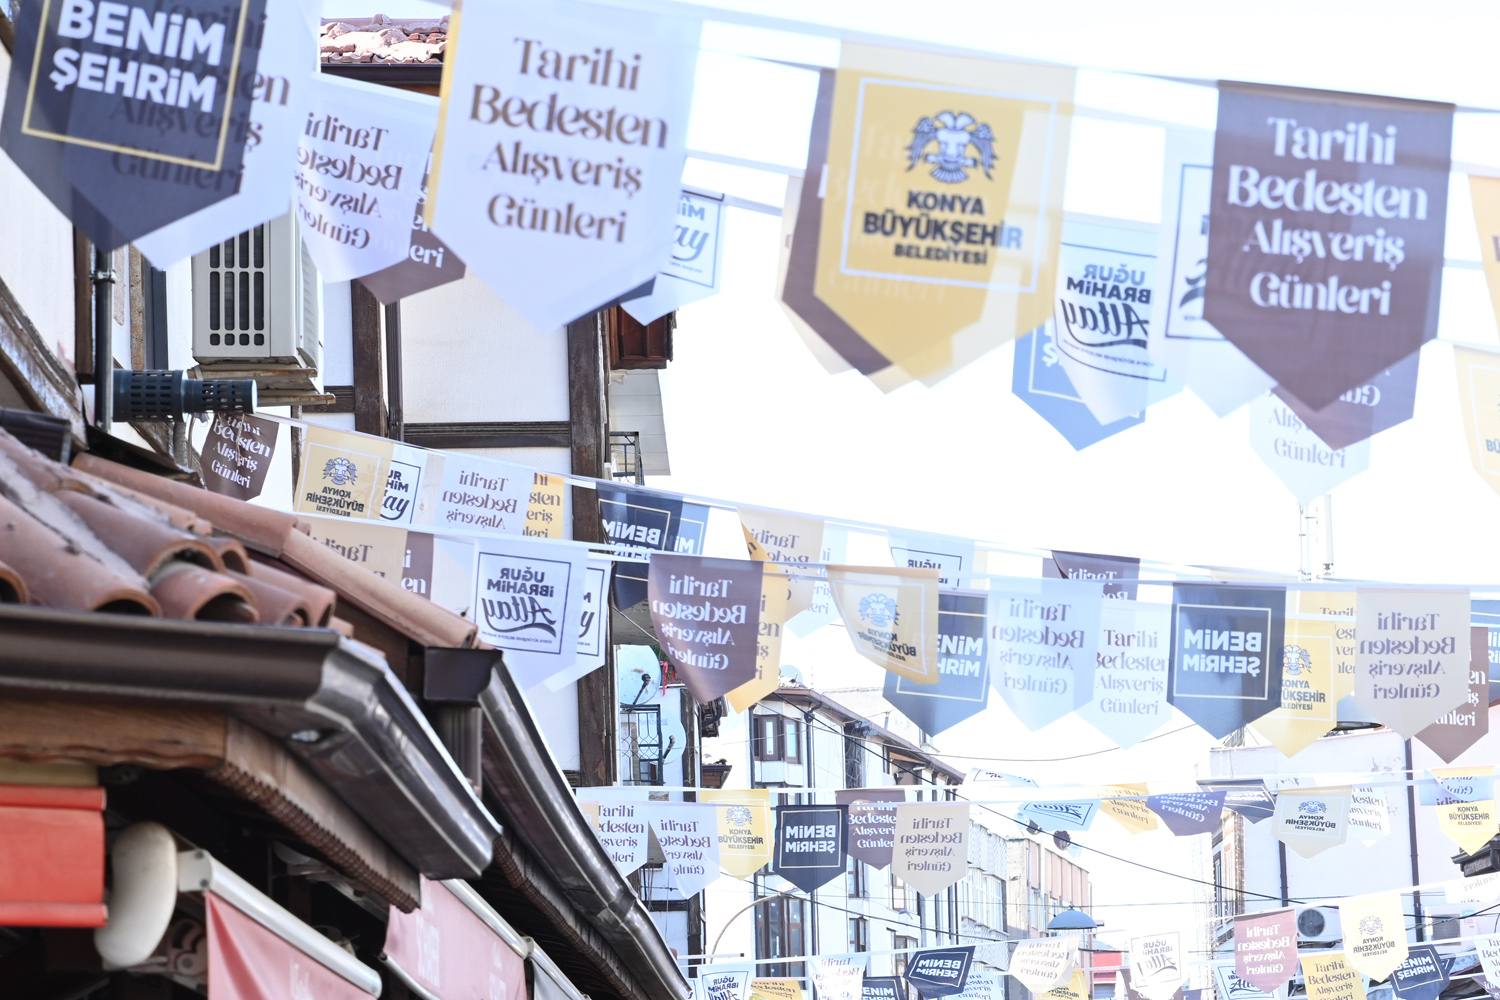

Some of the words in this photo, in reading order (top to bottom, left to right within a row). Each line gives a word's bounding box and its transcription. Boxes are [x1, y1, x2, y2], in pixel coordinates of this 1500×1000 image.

[513, 36, 642, 92] Tarihi
[469, 84, 668, 150] Bedesten
[1265, 114, 1397, 166] Tarihi
[908, 190, 985, 218] KONYA
[1226, 163, 1428, 221] Bedesten
[486, 192, 627, 243] Günleri
[863, 210, 1023, 251] BÜYÜKŞEHİR
[1248, 271, 1393, 315] Günleri
[1104, 629, 1158, 648] Tarihi
[1100, 698, 1158, 716] Günleri
